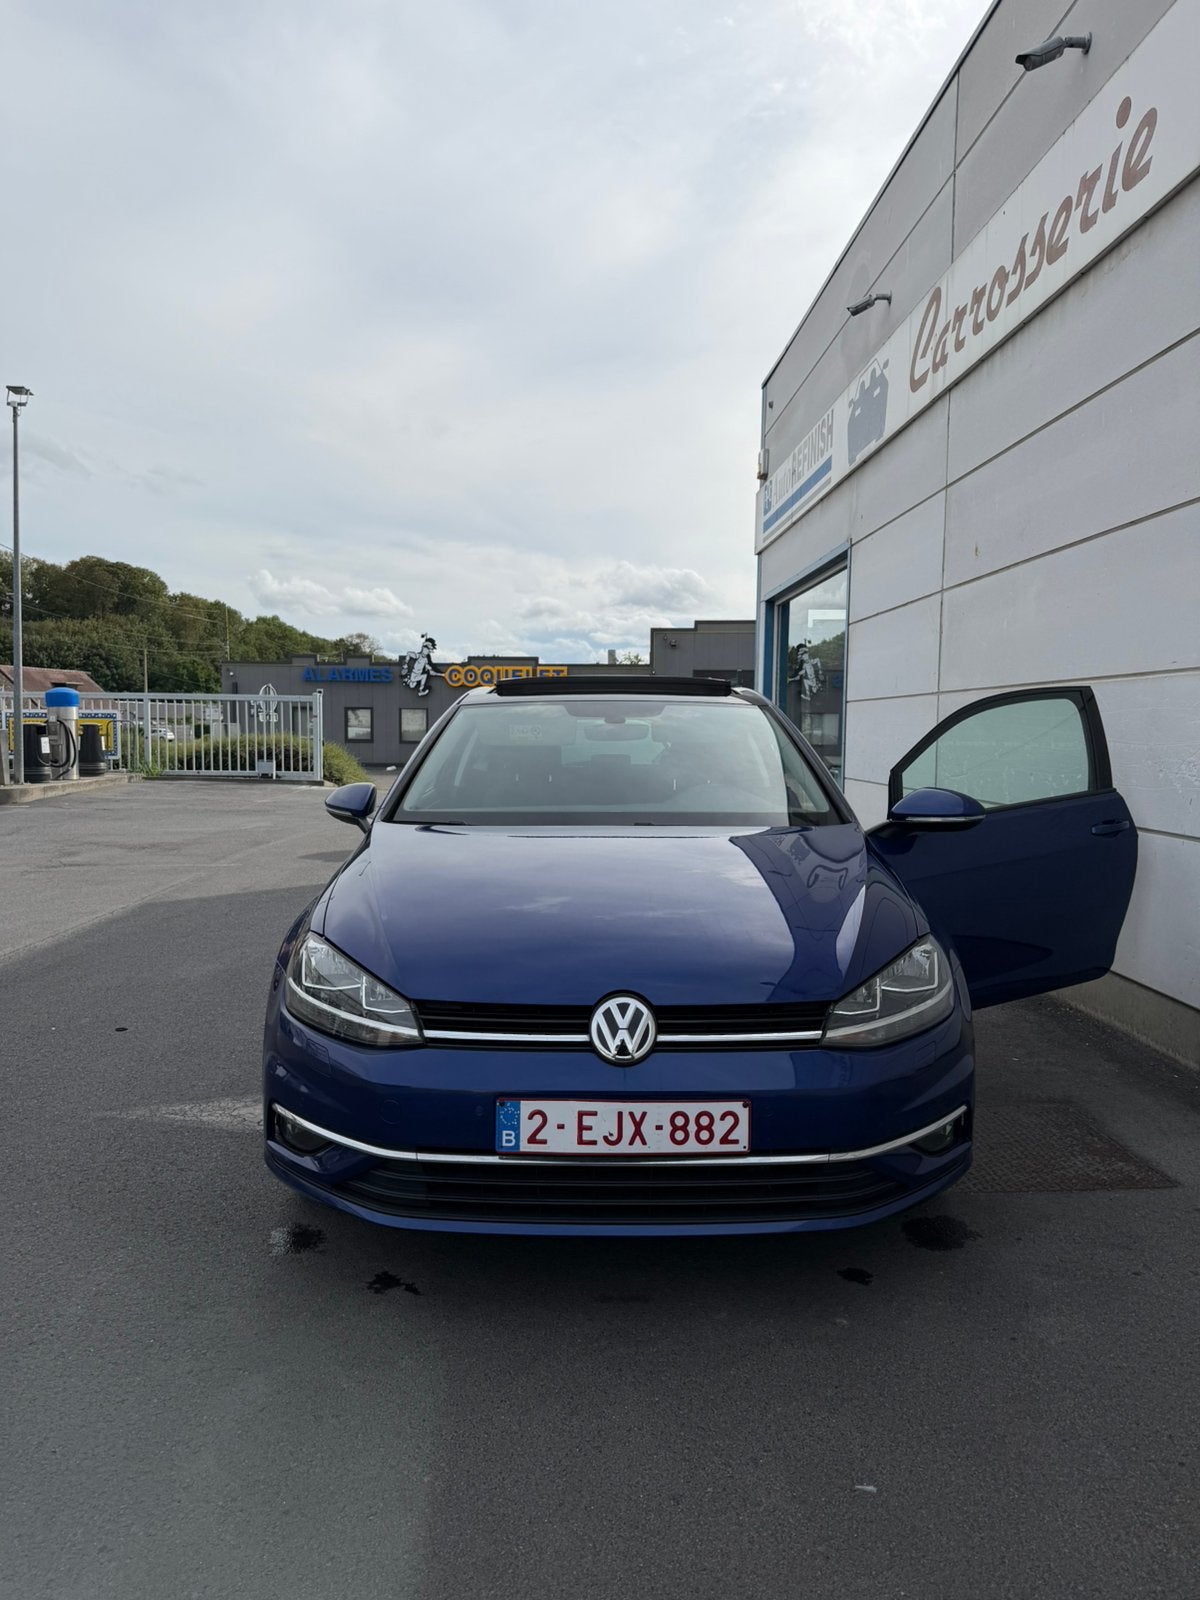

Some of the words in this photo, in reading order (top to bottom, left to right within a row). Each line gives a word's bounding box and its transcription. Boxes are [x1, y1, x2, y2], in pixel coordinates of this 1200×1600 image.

[909, 96, 1158, 393] Carrosserie
[302, 666, 393, 682] ALARMES
[501, 1130, 515, 1147] B
[526, 1109, 740, 1146] 2-EJX-882
